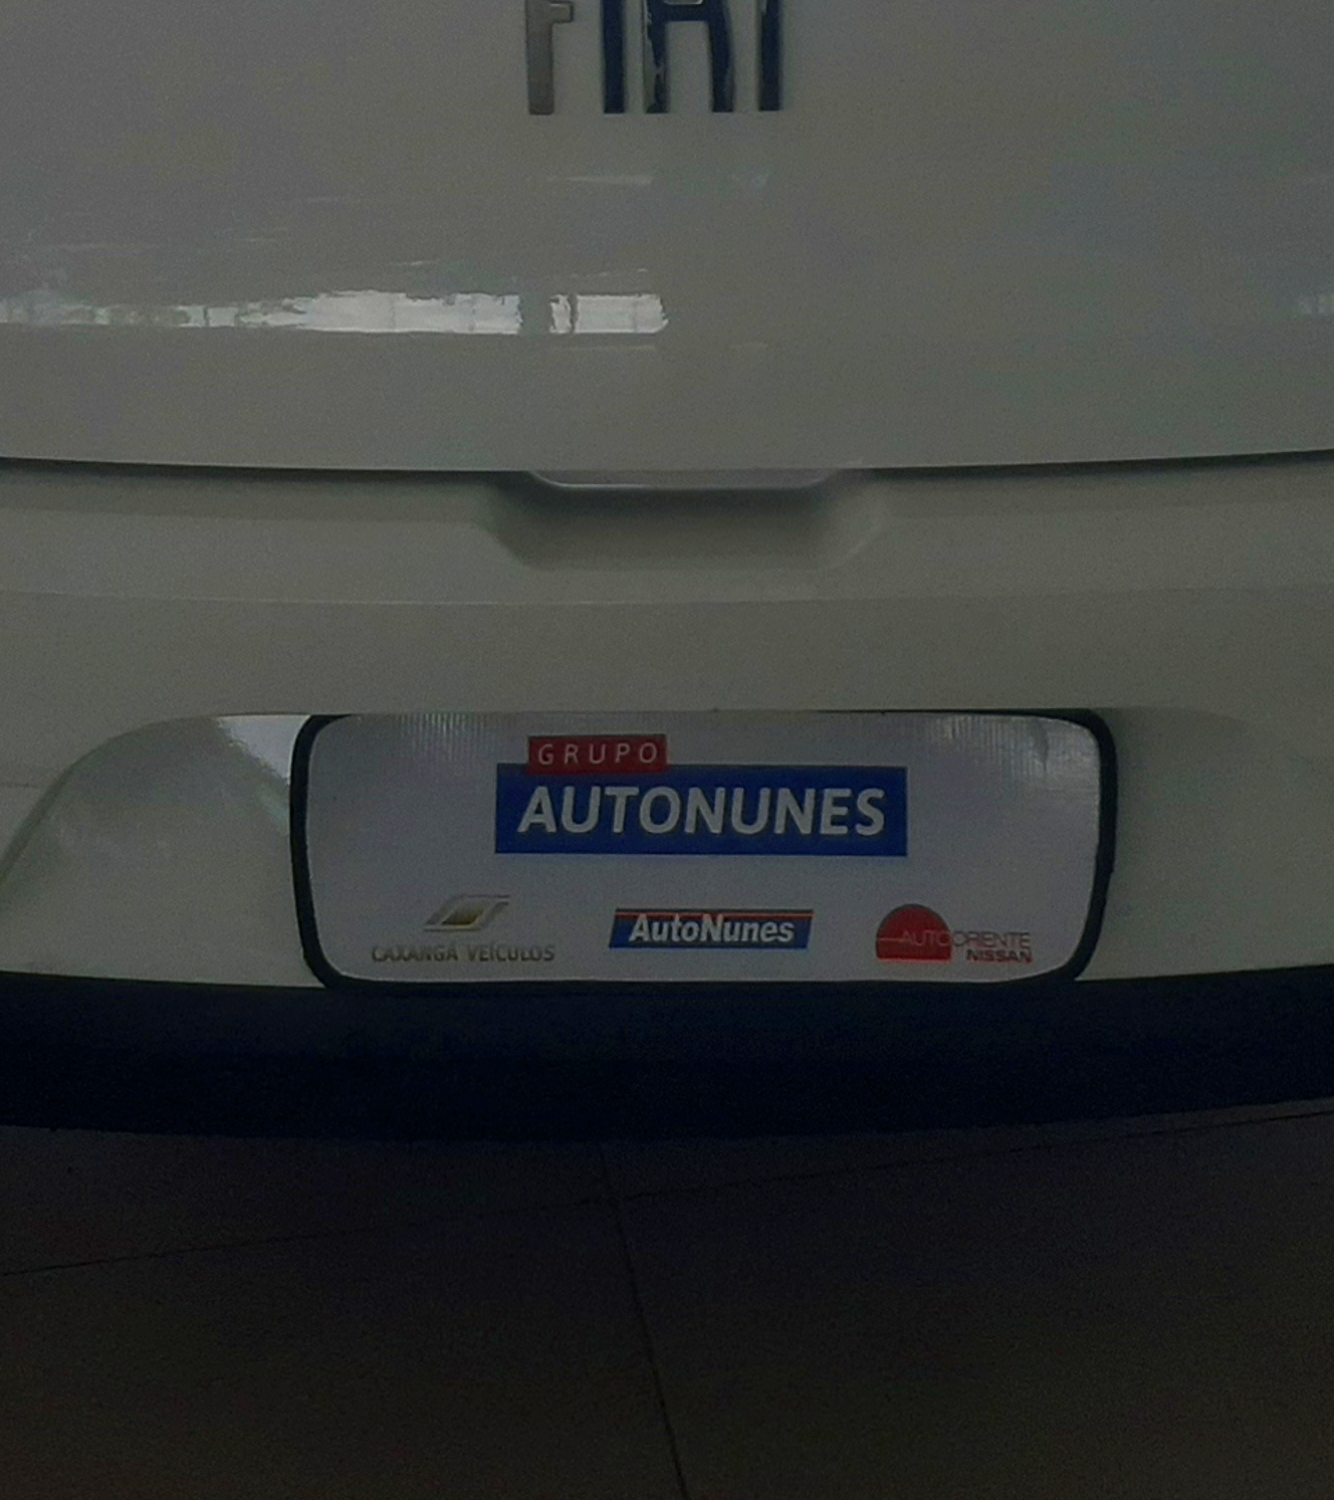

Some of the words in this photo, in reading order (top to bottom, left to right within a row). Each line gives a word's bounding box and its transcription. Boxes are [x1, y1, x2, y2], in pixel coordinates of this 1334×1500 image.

[535, 739, 661, 767] GRUPO
[517, 785, 886, 838] AUTONUNES
[628, 912, 796, 947] AutoNunes
[467, 941, 556, 963] VEÍCULOS
[966, 949, 1033, 964] NISSAN
